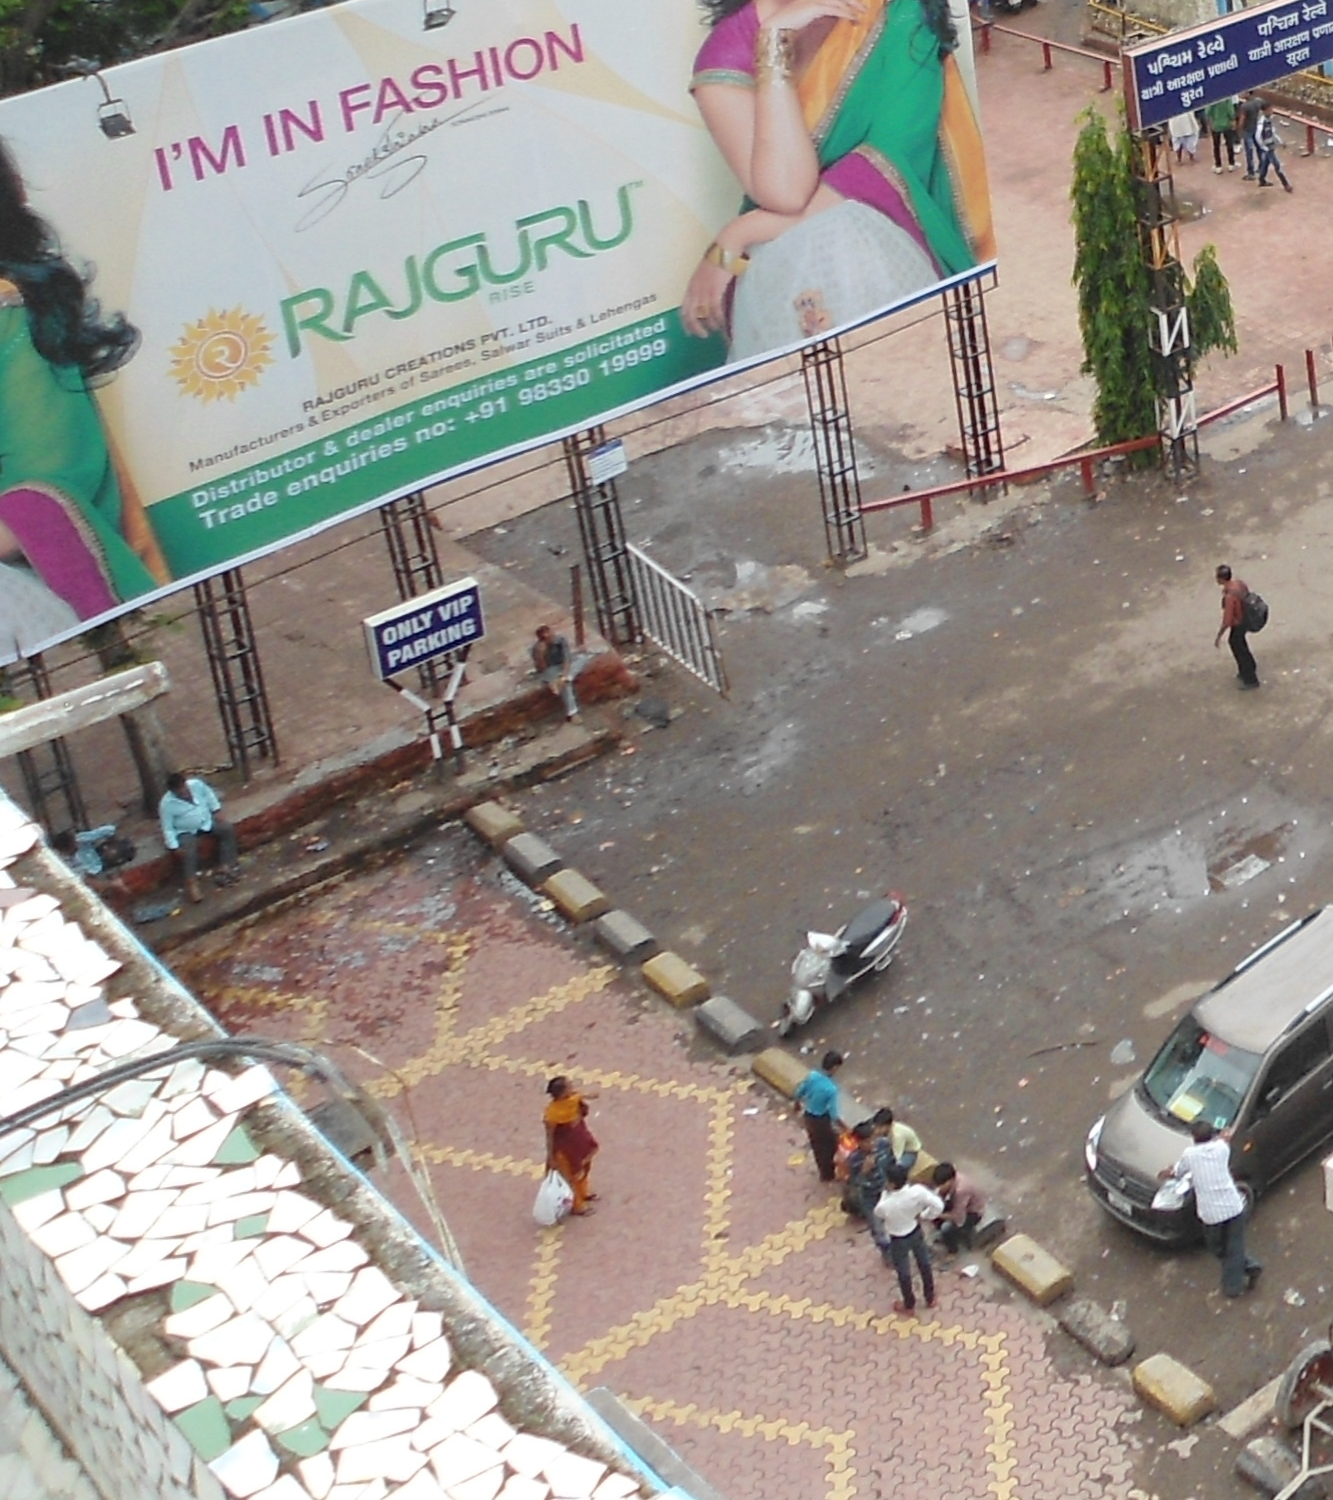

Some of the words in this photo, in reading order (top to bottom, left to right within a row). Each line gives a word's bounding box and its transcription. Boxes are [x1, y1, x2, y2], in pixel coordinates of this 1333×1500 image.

[153, 124, 247, 192] I'M
[263, 99, 323, 157] IN
[338, 23, 586, 134] FASHION
[279, 184, 634, 360] RAJGURU
[488, 281, 537, 305] RISE
[188, 426, 305, 474] Manufacturers
[307, 413, 319, 428] &
[320, 386, 396, 424] Exporters
[398, 378, 416, 393] of
[419, 357, 477, 386] Sarees,
[480, 336, 531, 362] Salwar
[535, 323, 573, 347] Suits
[575, 315, 587, 331] &
[589, 292, 658, 327] Lehengas
[191, 450, 317, 511] Distributor
[323, 439, 340, 457] &
[346, 411, 415, 451] dealer
[421, 373, 518, 417] enquiries
[523, 359, 558, 379] are
[563, 316, 667, 367] solicitated
[200, 487, 279, 532] Trade
[287, 437, 408, 497] enquiries
[414, 415, 457, 443] no:
[463, 395, 508, 429] +91
[517, 369, 591, 408] 98330
[597, 337, 668, 379] 19999
[302, 374, 379, 414] RAJGURU
[384, 339, 477, 378] CREATIONS
[480, 326, 515, 348] PVT.
[517, 315, 553, 337] LTD.
[382, 609, 433, 646] ONLY
[438, 594, 474, 622] VIP
[388, 618, 476, 668] PARKING
